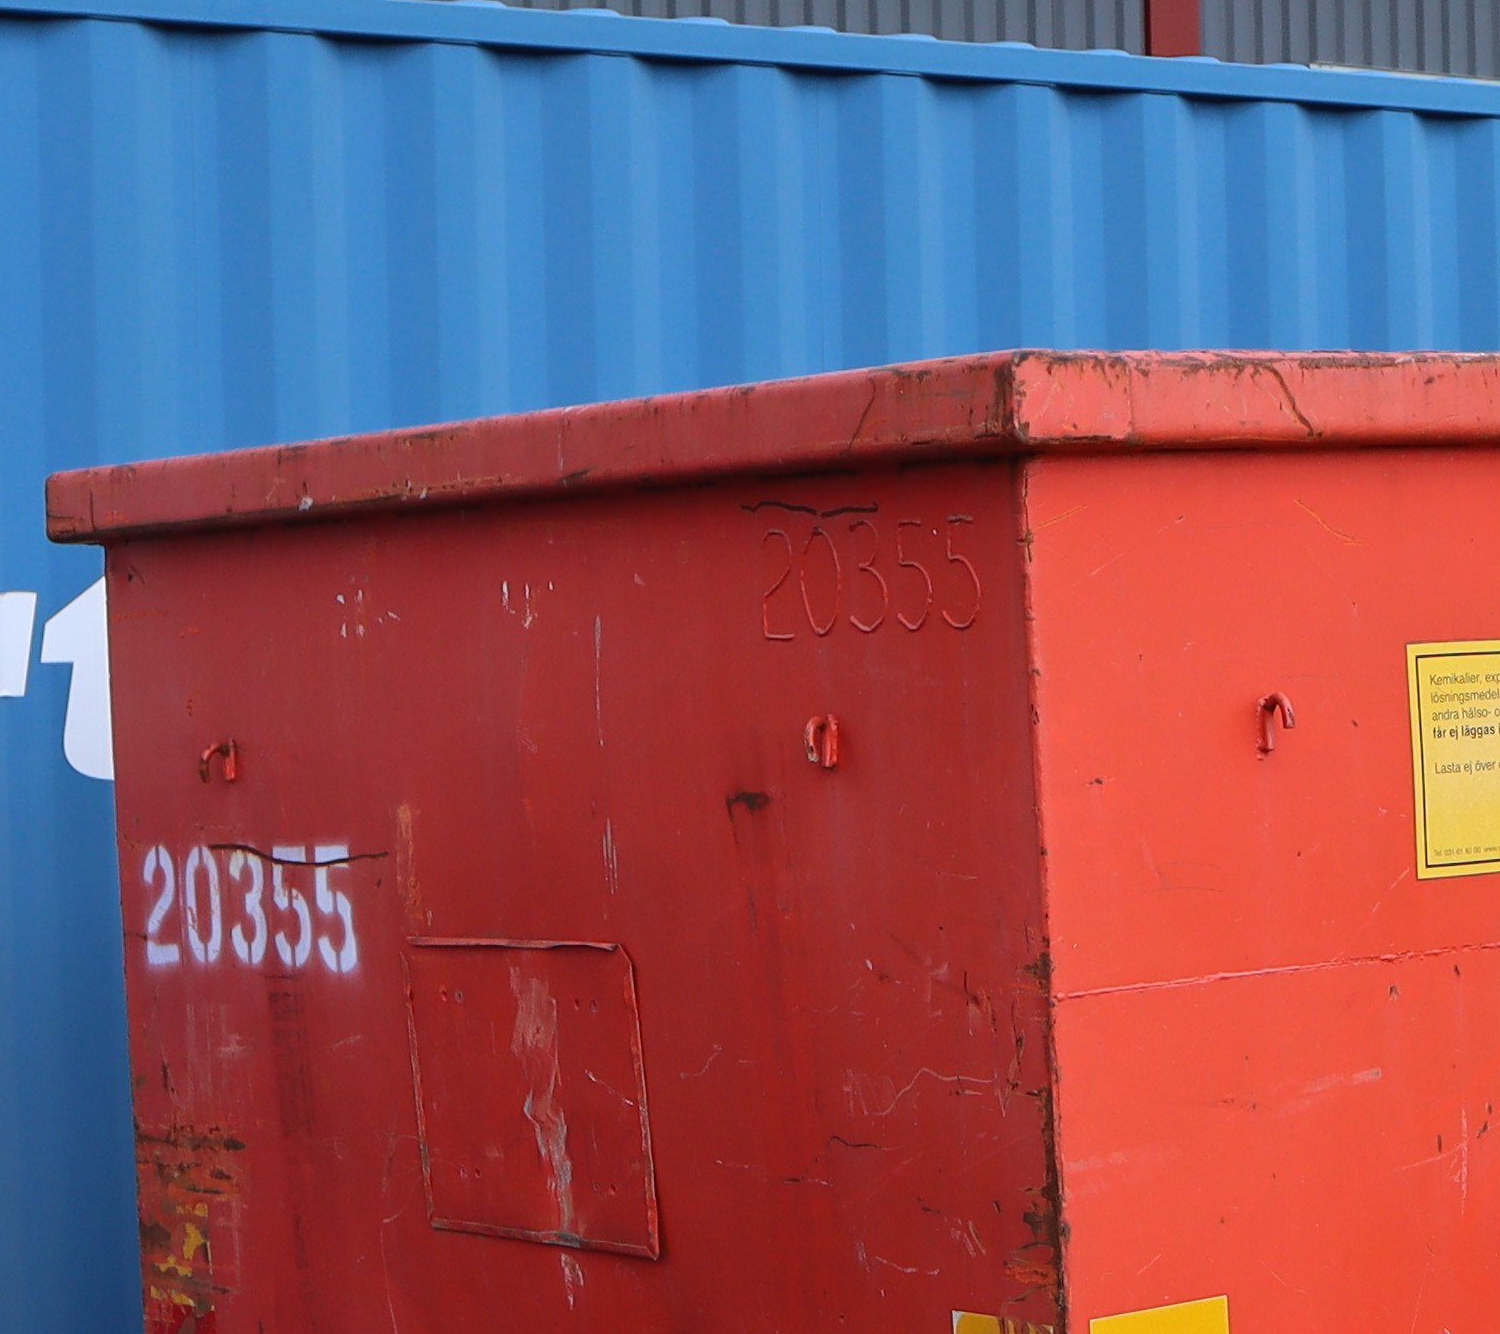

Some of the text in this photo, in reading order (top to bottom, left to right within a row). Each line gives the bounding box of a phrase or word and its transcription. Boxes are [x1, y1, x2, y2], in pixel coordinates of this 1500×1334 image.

[762, 513, 981, 643] 20355
[1432, 709, 1459, 722] andra
[1449, 726, 1459, 740] ej
[1461, 725, 1496, 739] läggas
[1434, 762, 1461, 774] Lasta
[1463, 760, 1473, 775] ej
[143, 844, 359, 974] 20355
